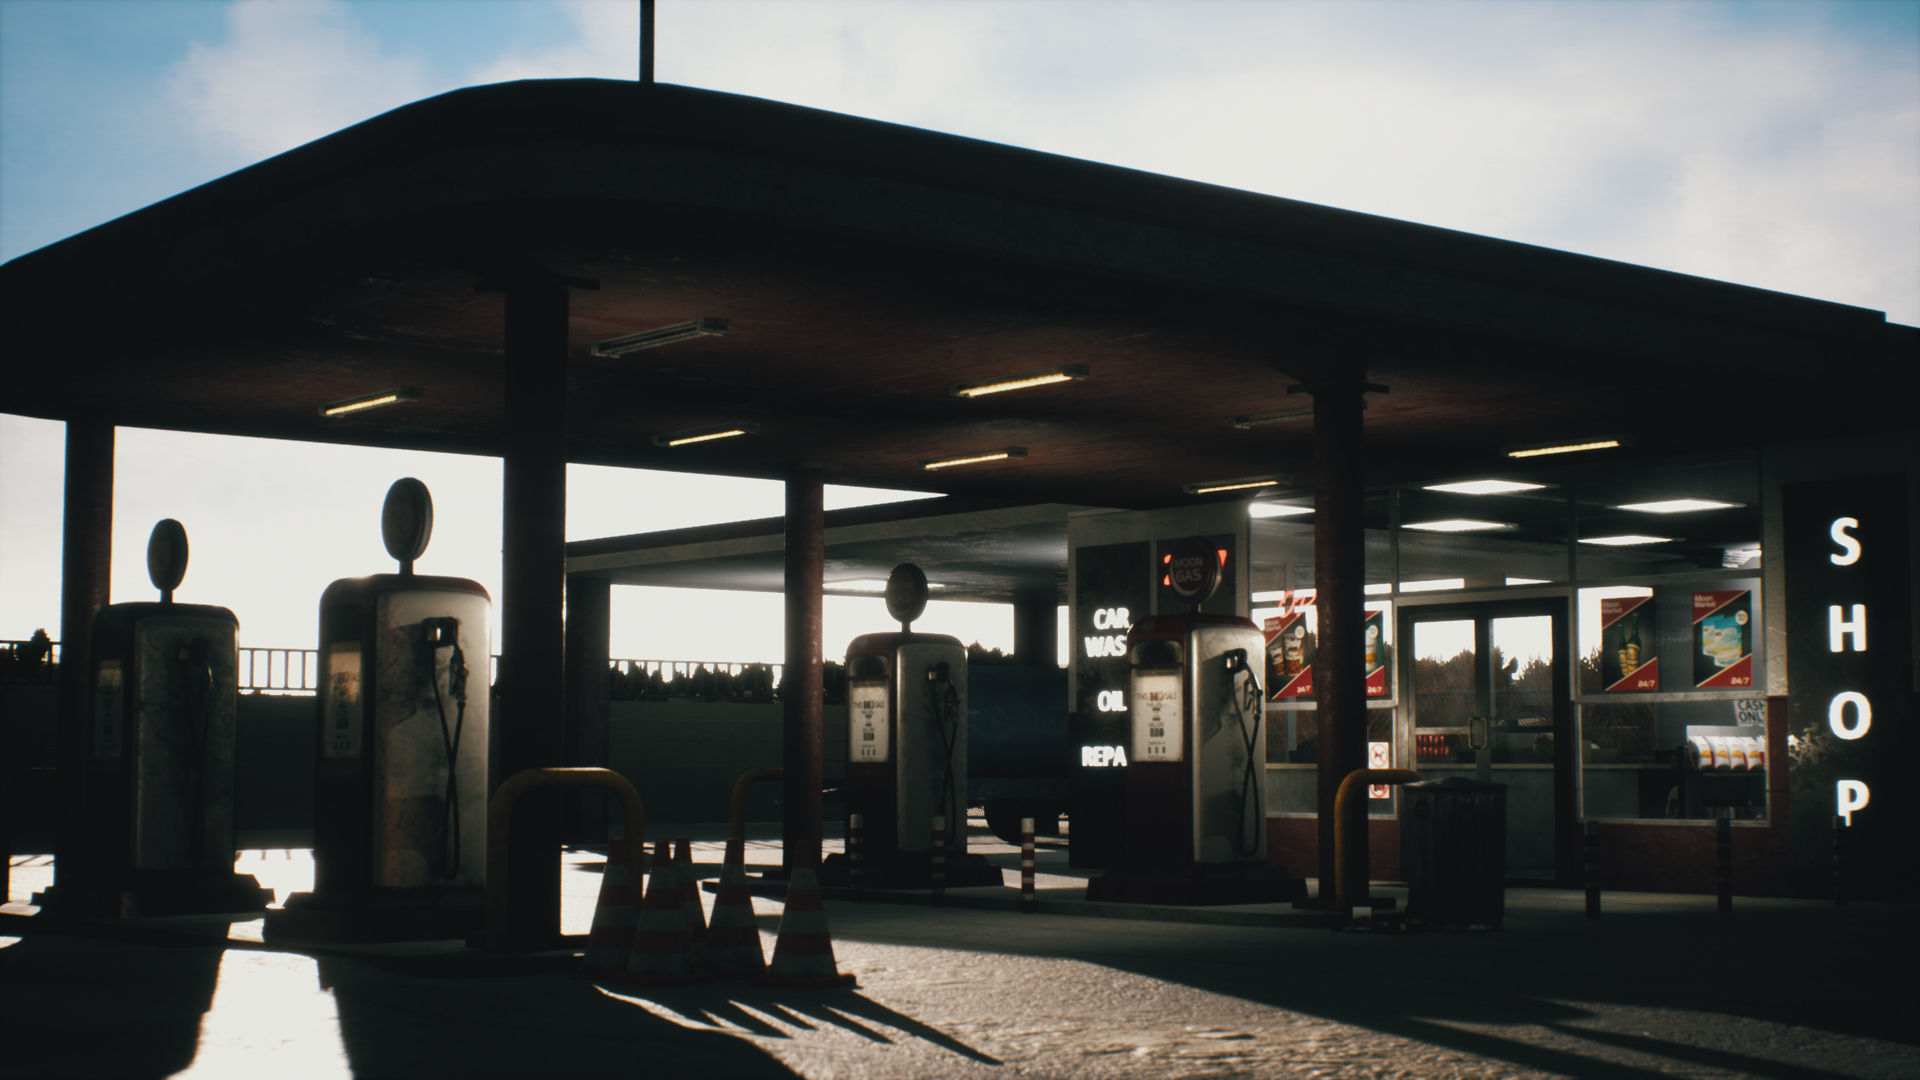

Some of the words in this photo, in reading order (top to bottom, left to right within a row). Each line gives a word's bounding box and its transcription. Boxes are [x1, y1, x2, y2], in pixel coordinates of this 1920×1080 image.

[1174, 556, 1204, 568] MOON
[1175, 568, 1202, 583] GAS
[1093, 607, 1130, 630] CAR
[1084, 635, 1127, 657] WAS
[1730, 677, 1750, 685] 24/7
[1828, 516, 1873, 828] SHOP
[1097, 690, 1128, 713] OIL
[1082, 746, 1128, 767] REPA
